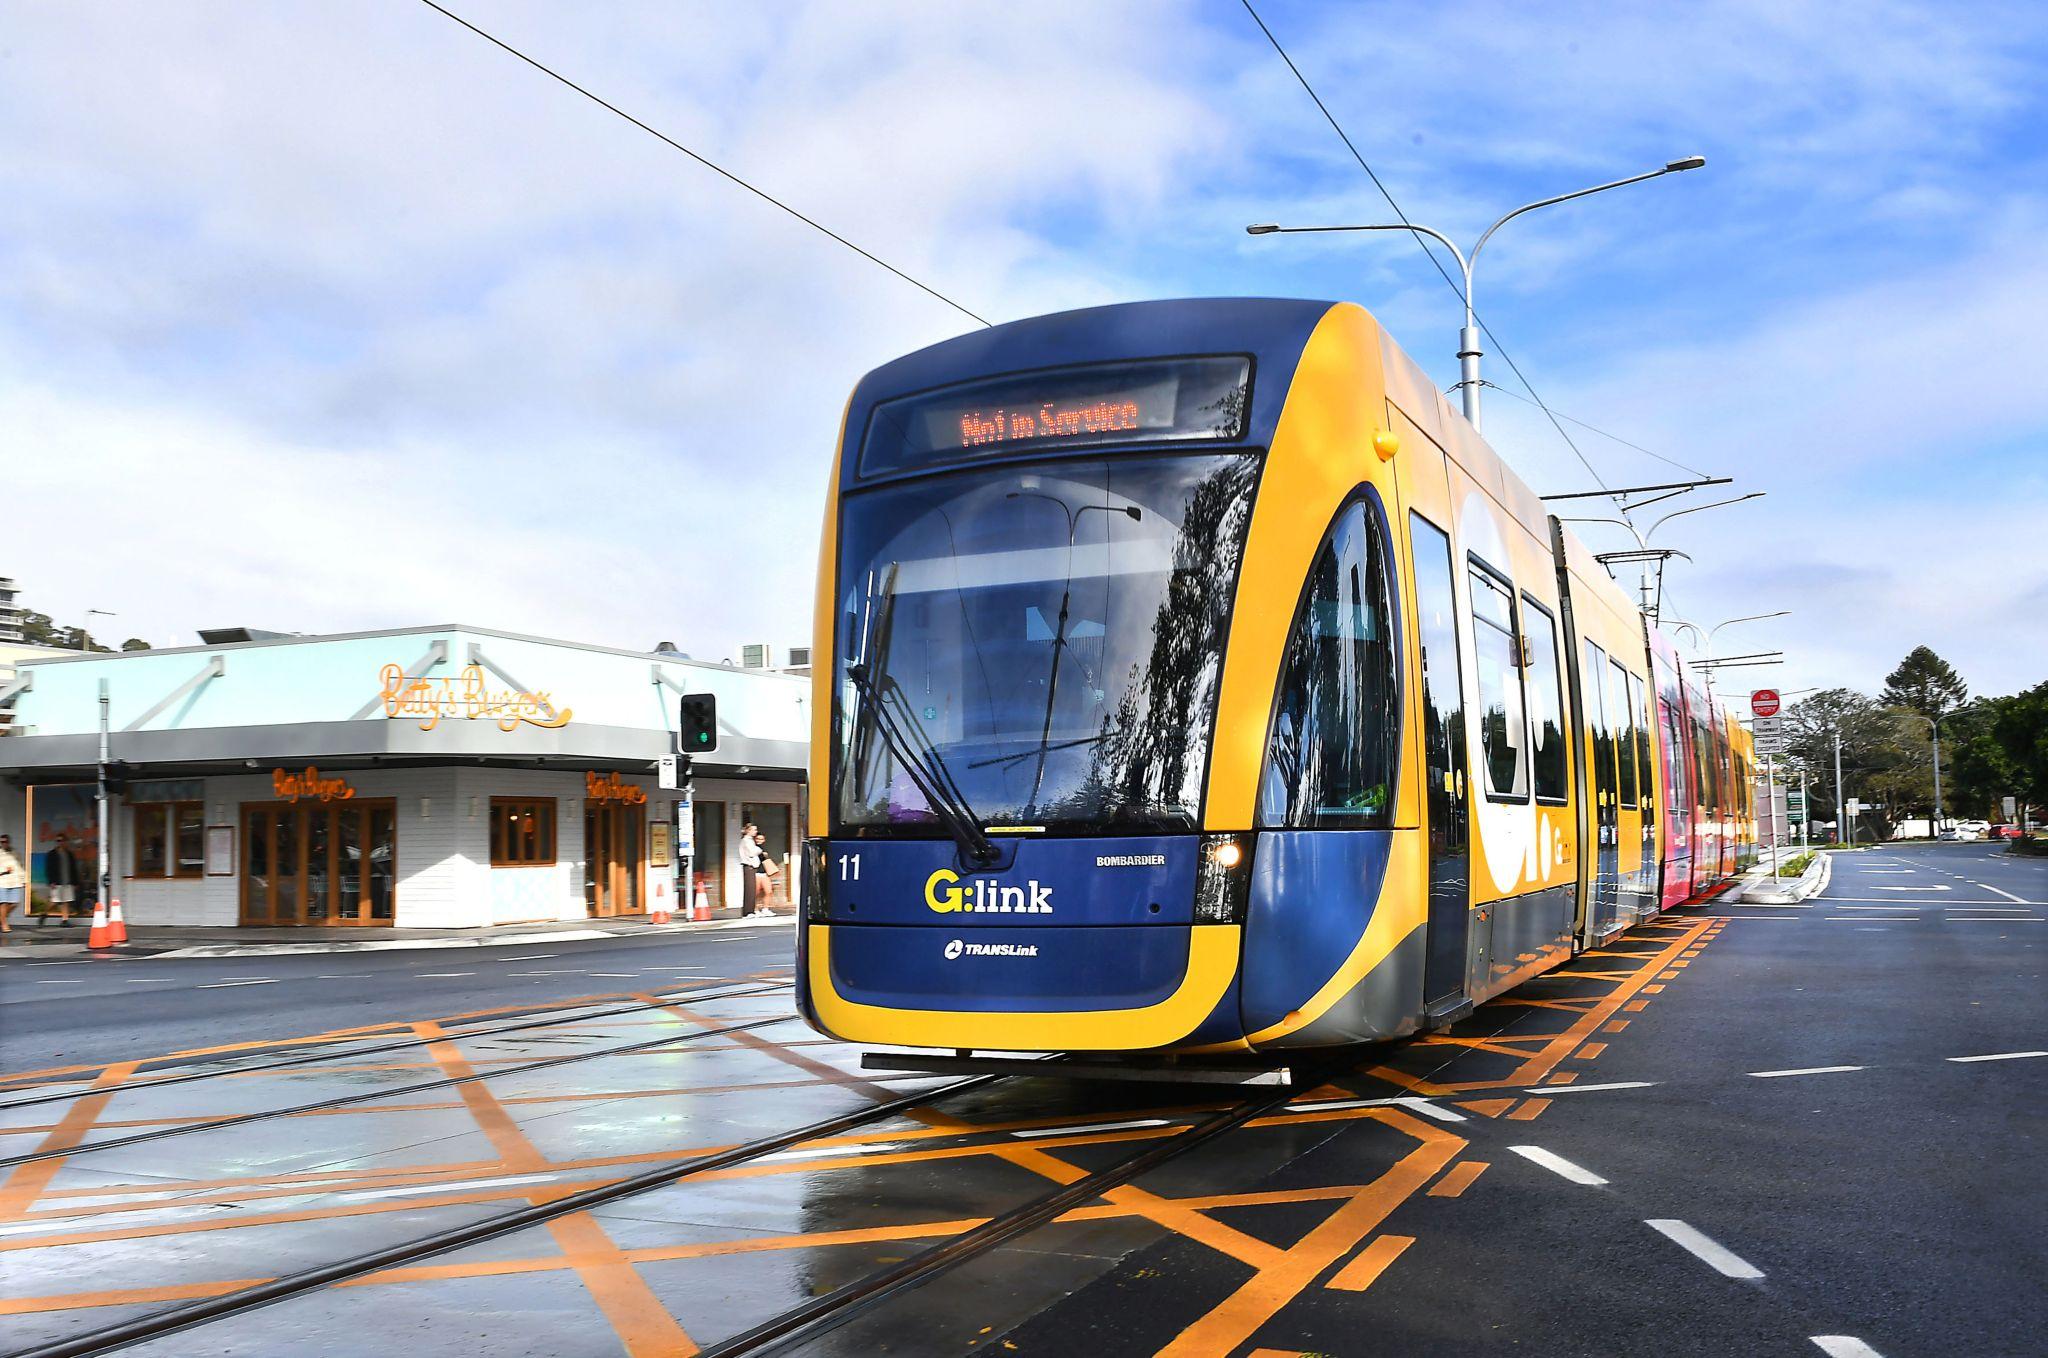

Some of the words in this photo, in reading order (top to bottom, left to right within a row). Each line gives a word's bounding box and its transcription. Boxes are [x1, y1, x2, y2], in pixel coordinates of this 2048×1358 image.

[962, 410, 1006, 447] Not
[1011, 413, 1034, 439] in
[1039, 401, 1137, 437] Service
[379, 663, 457, 731] Betty's
[461, 664, 572, 731] Burgers
[838, 853, 861, 881] 11
[1096, 853, 1166, 868] BOMBARDIER
[924, 868, 1054, 915] G:link
